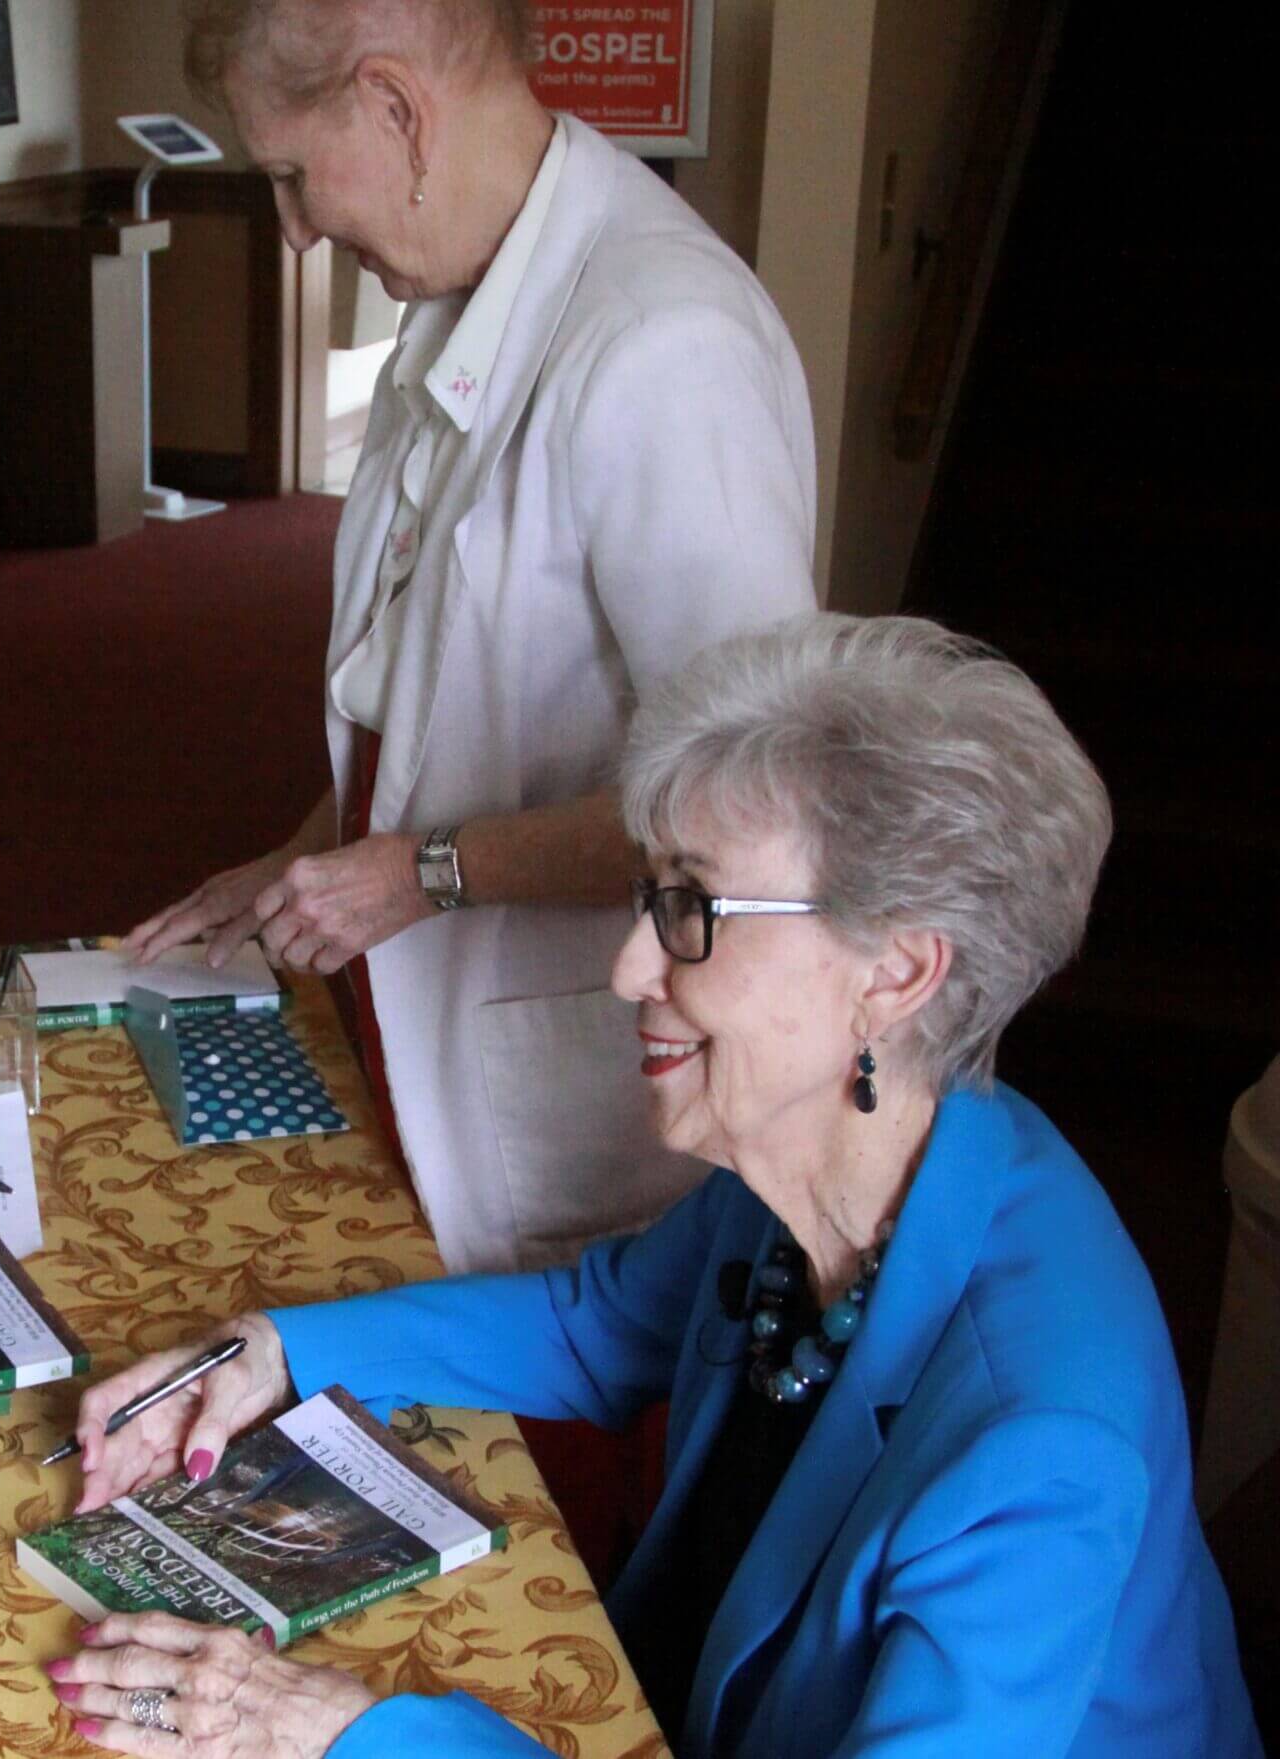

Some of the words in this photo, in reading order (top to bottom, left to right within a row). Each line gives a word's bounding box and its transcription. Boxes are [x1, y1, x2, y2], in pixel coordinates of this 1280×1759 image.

[534, 8, 568, 21] ET'S
[573, 7, 636, 22] SPREAD
[641, 7, 671, 22] THE
[537, 72, 569, 86] (not
[573, 72, 597, 85] the
[602, 72, 656, 87] germs)
[57, 1013, 90, 1025] PORTER
[301, 1434, 376, 1496] PORTER
[380, 1499, 426, 1530] GAIL
[77, 1547, 107, 1567] ON
[98, 1541, 125, 1557] OF
[102, 1566, 156, 1603] LIVING
[120, 1529, 246, 1620] FREEDOM
[121, 1555, 160, 1587] PATH
[158, 1579, 192, 1610] THE
[300, 1613, 330, 1629] Living
[329, 1607, 342, 1617] on
[344, 1598, 359, 1611] the
[360, 1588, 380, 1603] Path
[381, 1581, 393, 1594] of
[392, 1567, 429, 1589] Freedom
